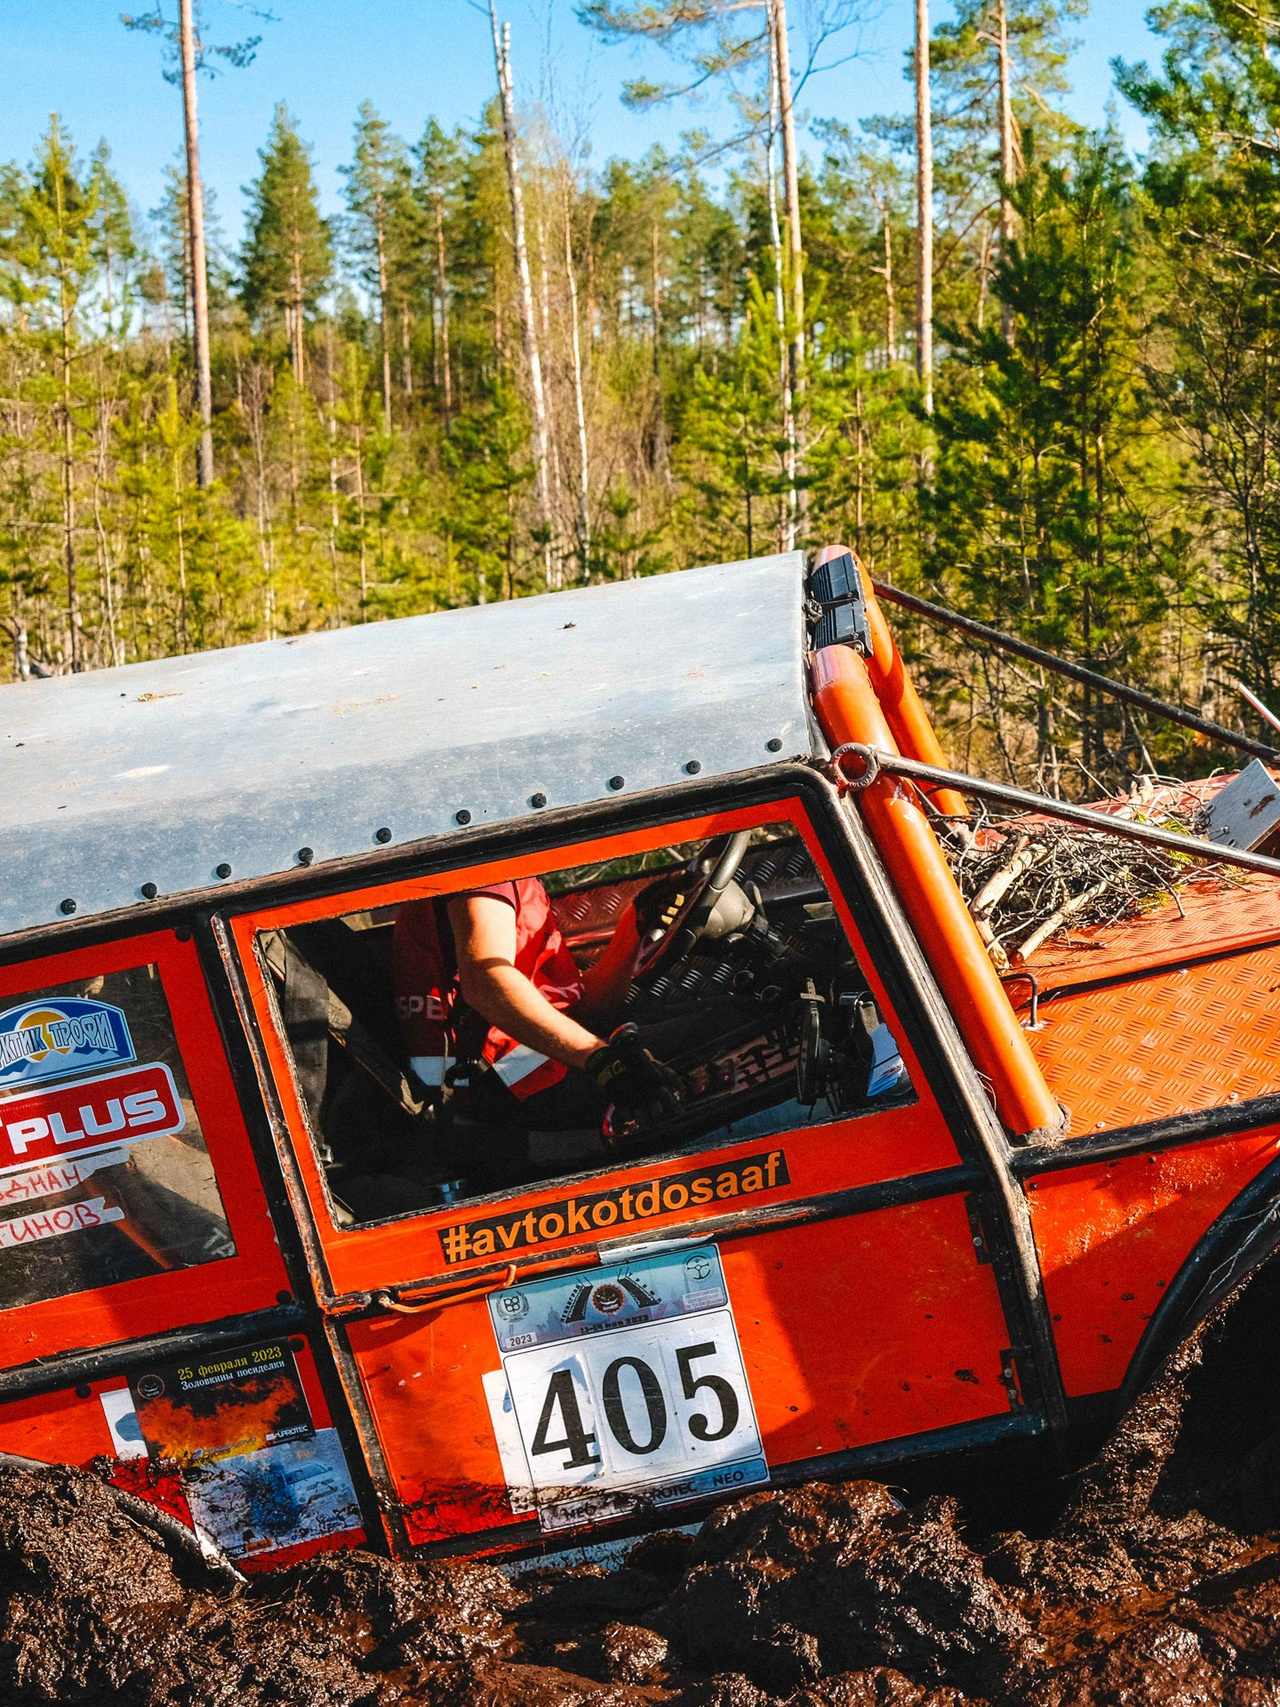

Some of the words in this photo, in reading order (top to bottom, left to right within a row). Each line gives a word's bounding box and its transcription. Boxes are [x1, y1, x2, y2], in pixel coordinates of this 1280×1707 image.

[49, 1012, 116, 1049] ТРОФИ
[0, 1090, 167, 1155] PLUS
[442, 1150, 782, 1263] #avtokotdosaaf
[509, 1333, 534, 1347] 2023
[177, 1366, 194, 1381] 25
[198, 1357, 248, 1378] февраля
[251, 1345, 283, 1364] 2023
[181, 1372, 234, 1391] Золовкины
[237, 1359, 286, 1378] посиделки
[530, 1340, 740, 1470] 405
[712, 1470, 744, 1487] NEO
